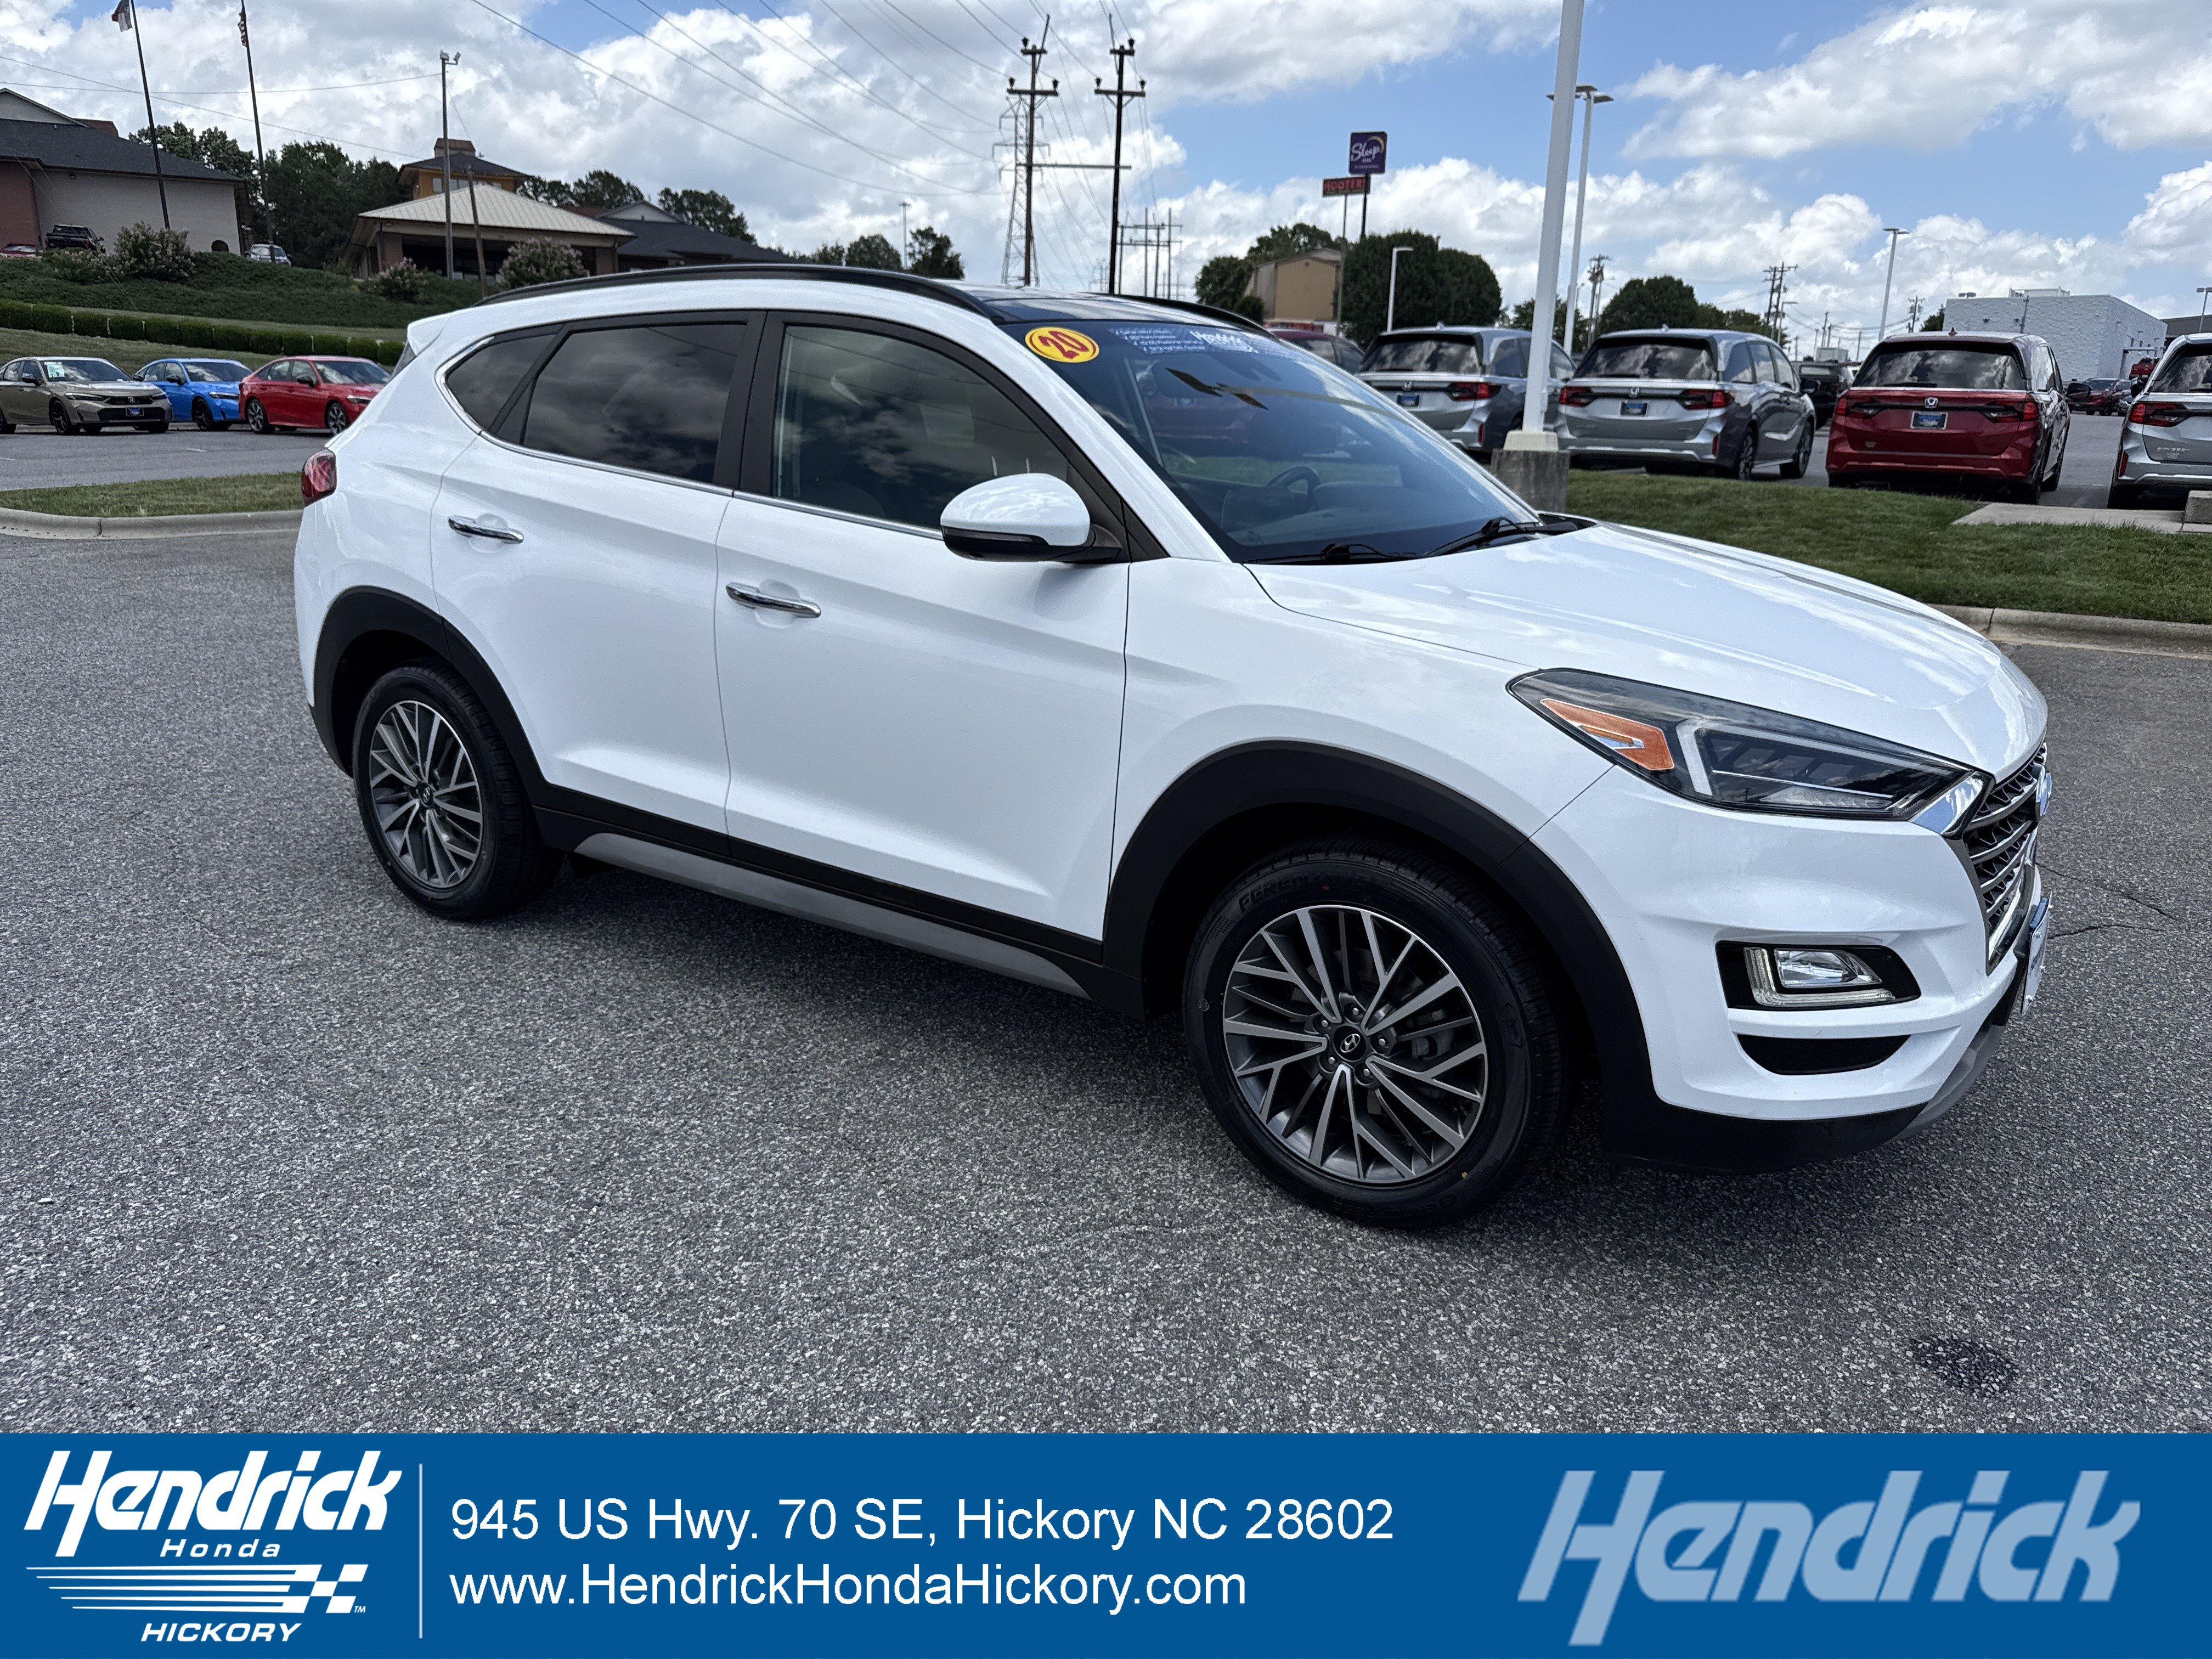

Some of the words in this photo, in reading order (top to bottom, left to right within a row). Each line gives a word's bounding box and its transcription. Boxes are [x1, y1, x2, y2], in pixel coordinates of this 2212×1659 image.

[1351, 142, 1380, 161] Sleep
[1324, 179, 1364, 190] HOOTER
[1038, 331, 1090, 359] 20
